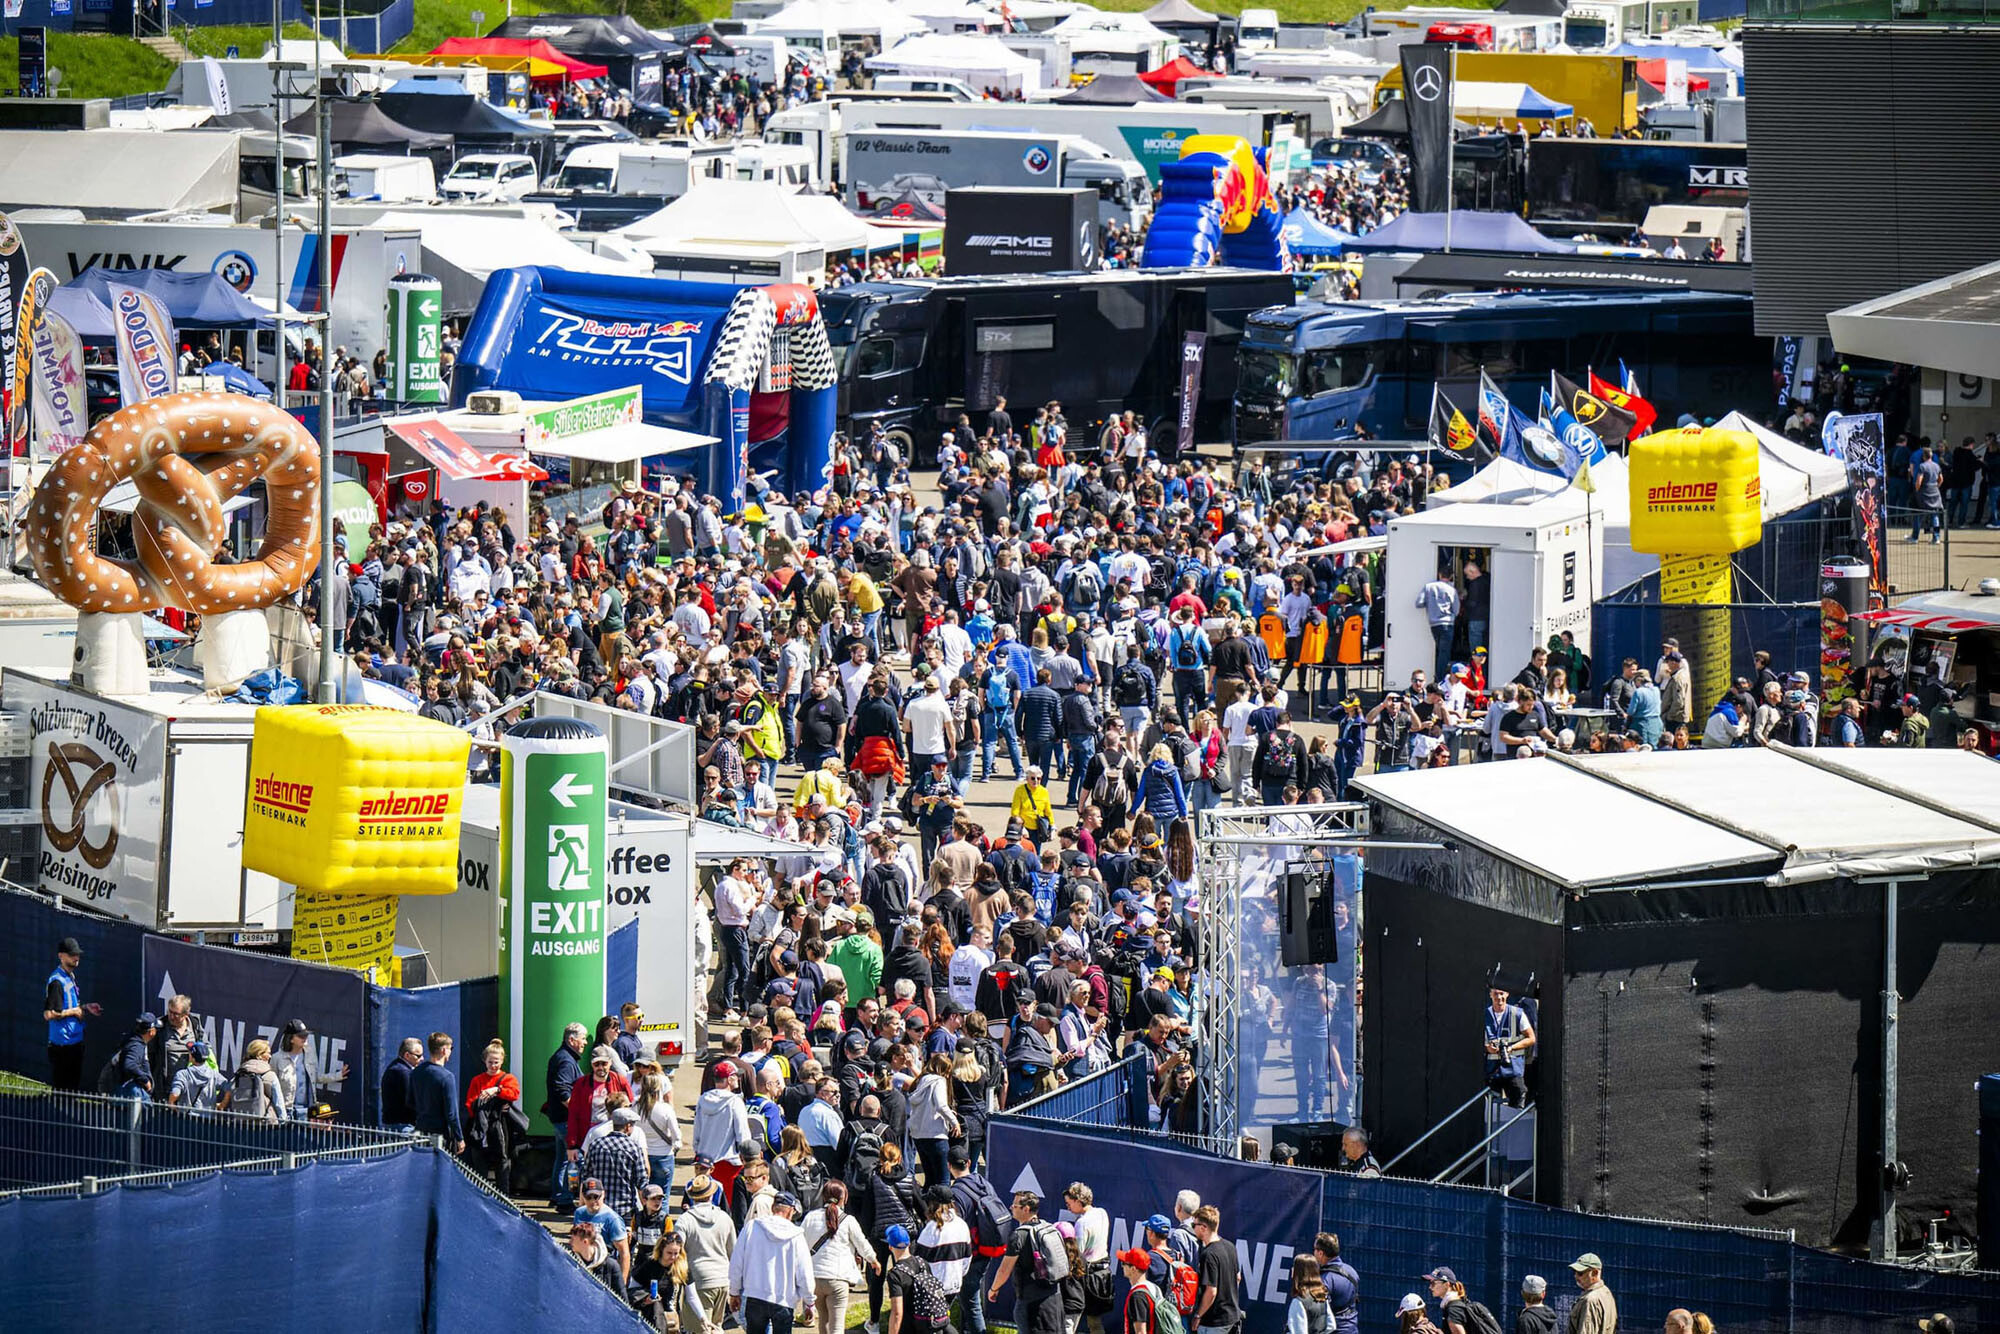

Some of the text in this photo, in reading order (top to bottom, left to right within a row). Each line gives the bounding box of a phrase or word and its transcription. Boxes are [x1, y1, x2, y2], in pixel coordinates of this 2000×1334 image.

[855, 140, 952, 154] 02 Classic Team
[926, 192, 934, 202] 2
[992, 236, 1053, 248] AMG
[1013, 250, 1053, 258] PERFORMANCE
[67, 252, 187, 279] VINK
[1504, 269, 1689, 286] Mercedes-Benz
[581, 319, 651, 338] Red Bull
[983, 331, 1012, 342] STX
[527, 346, 654, 367] AM SPIELBERG
[1184, 345, 1202, 362] STX
[409, 362, 440, 380] EXIT
[1958, 373, 1983, 401] 9
[1647, 480, 1719, 500] antenne
[1647, 504, 1716, 513] STEIERMARK
[30, 700, 138, 773] Salzburger Brezen
[255, 772, 314, 807] antenne
[359, 790, 449, 817] antenne
[252, 802, 307, 829] STEIERMARK
[357, 825, 444, 837] STEIERMARK
[39, 850, 118, 901] Reisinger
[531, 899, 602, 935] EXIT
[531, 938, 600, 957] AUSGANG
[189, 1012, 246, 1074] AN
